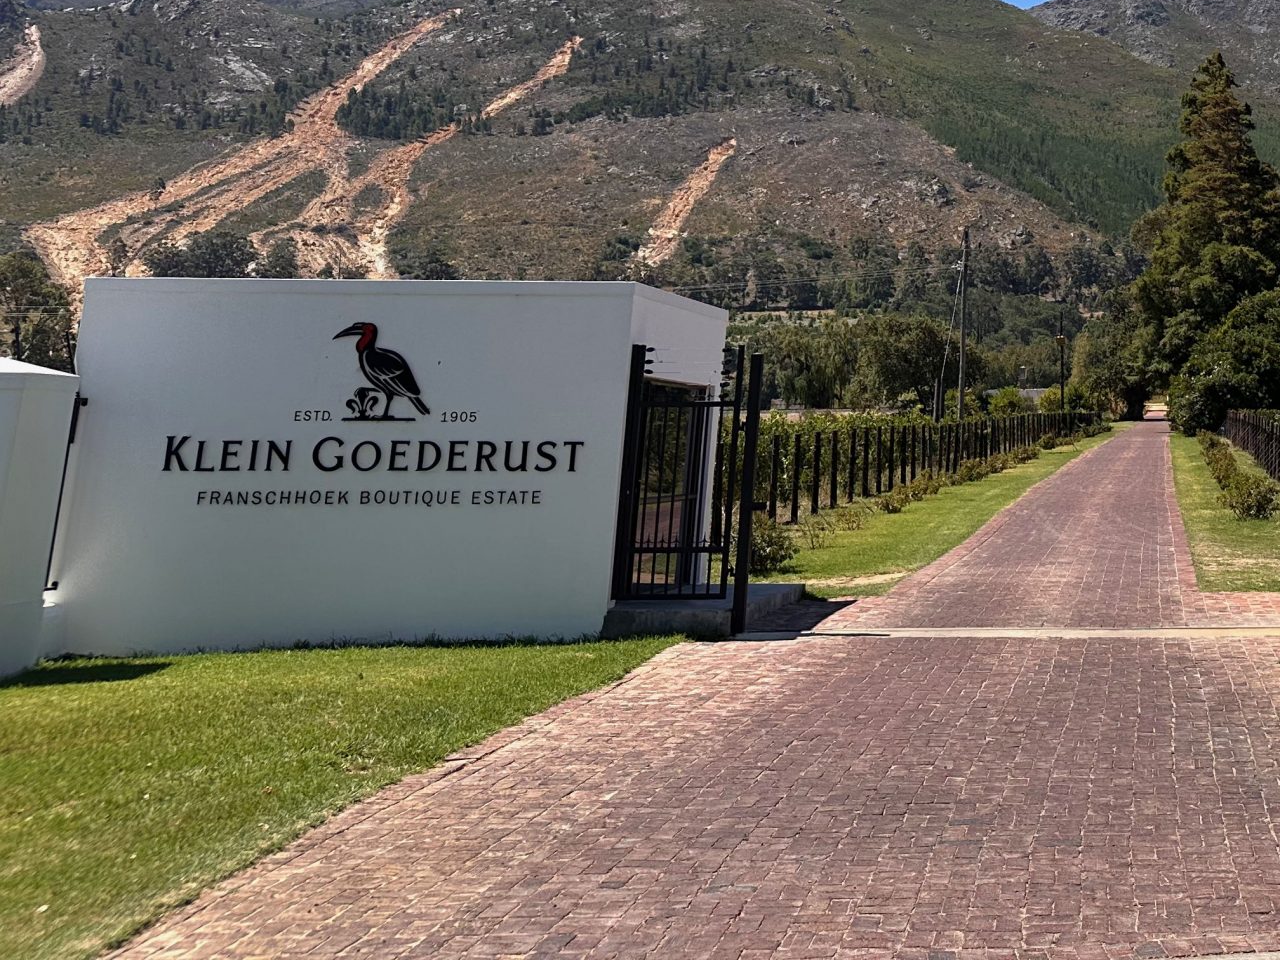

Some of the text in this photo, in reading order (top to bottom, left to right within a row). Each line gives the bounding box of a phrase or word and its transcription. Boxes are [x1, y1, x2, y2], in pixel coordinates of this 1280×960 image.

[294, 410, 478, 423] ESTD. 1905
[161, 435, 585, 473] KLEIN GOEDERUST
[196, 490, 543, 508] FRANSCHHOEK BOUTIQUE ESTATE
